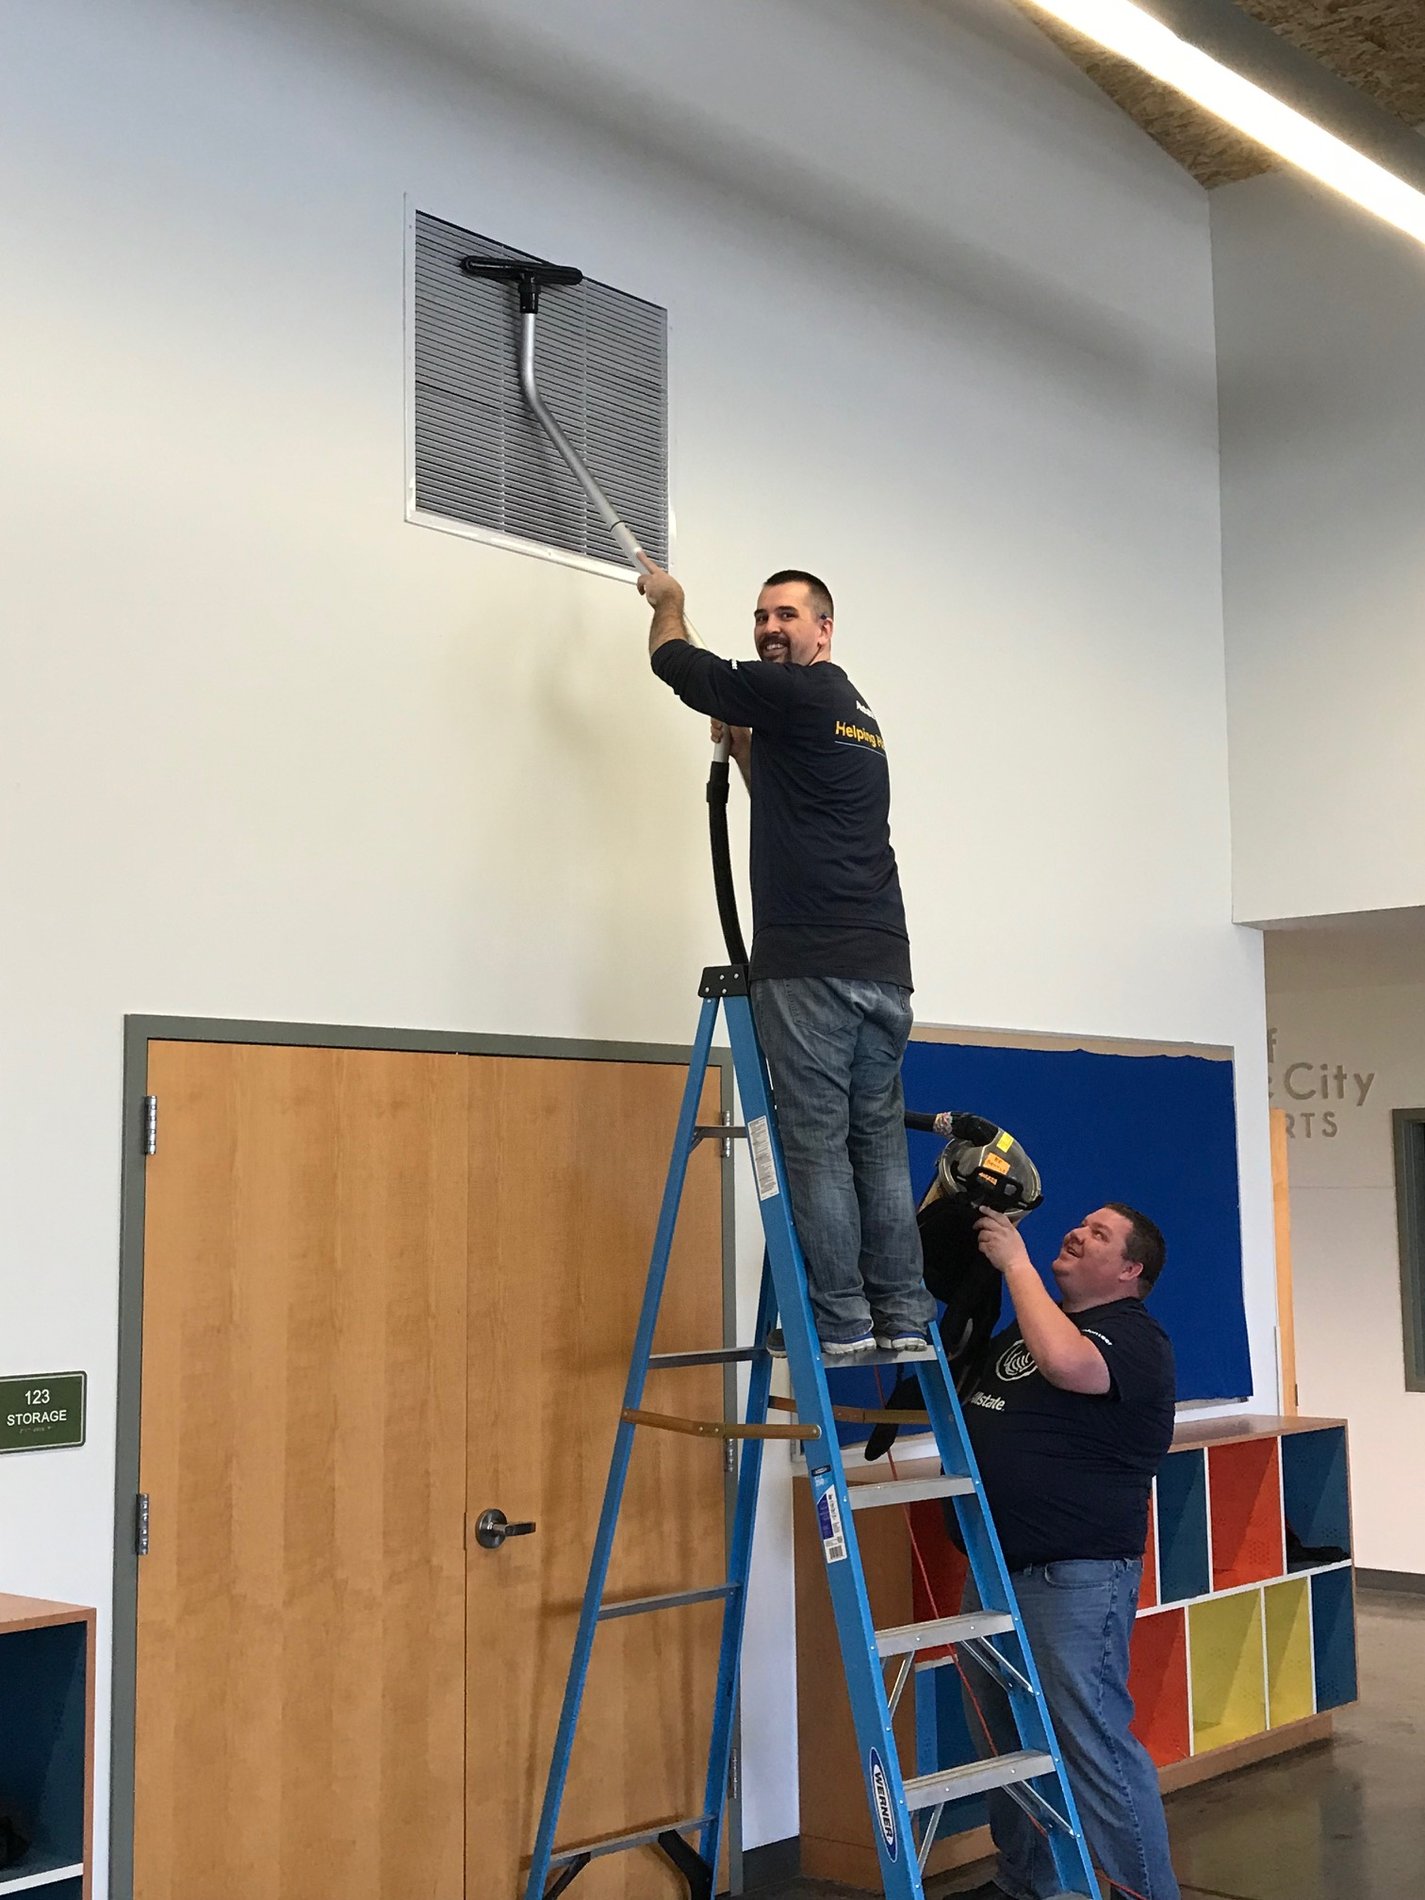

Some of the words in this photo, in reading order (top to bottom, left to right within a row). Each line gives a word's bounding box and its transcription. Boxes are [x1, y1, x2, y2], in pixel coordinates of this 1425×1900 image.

[835, 721, 877, 748] Helping
[1283, 1062, 1375, 1107] City
[25, 1389, 50, 1405] 123
[970, 1391, 1006, 1411] llstate
[6, 1409, 67, 1426] STORAGE
[874, 1771, 893, 1838] WERNER
